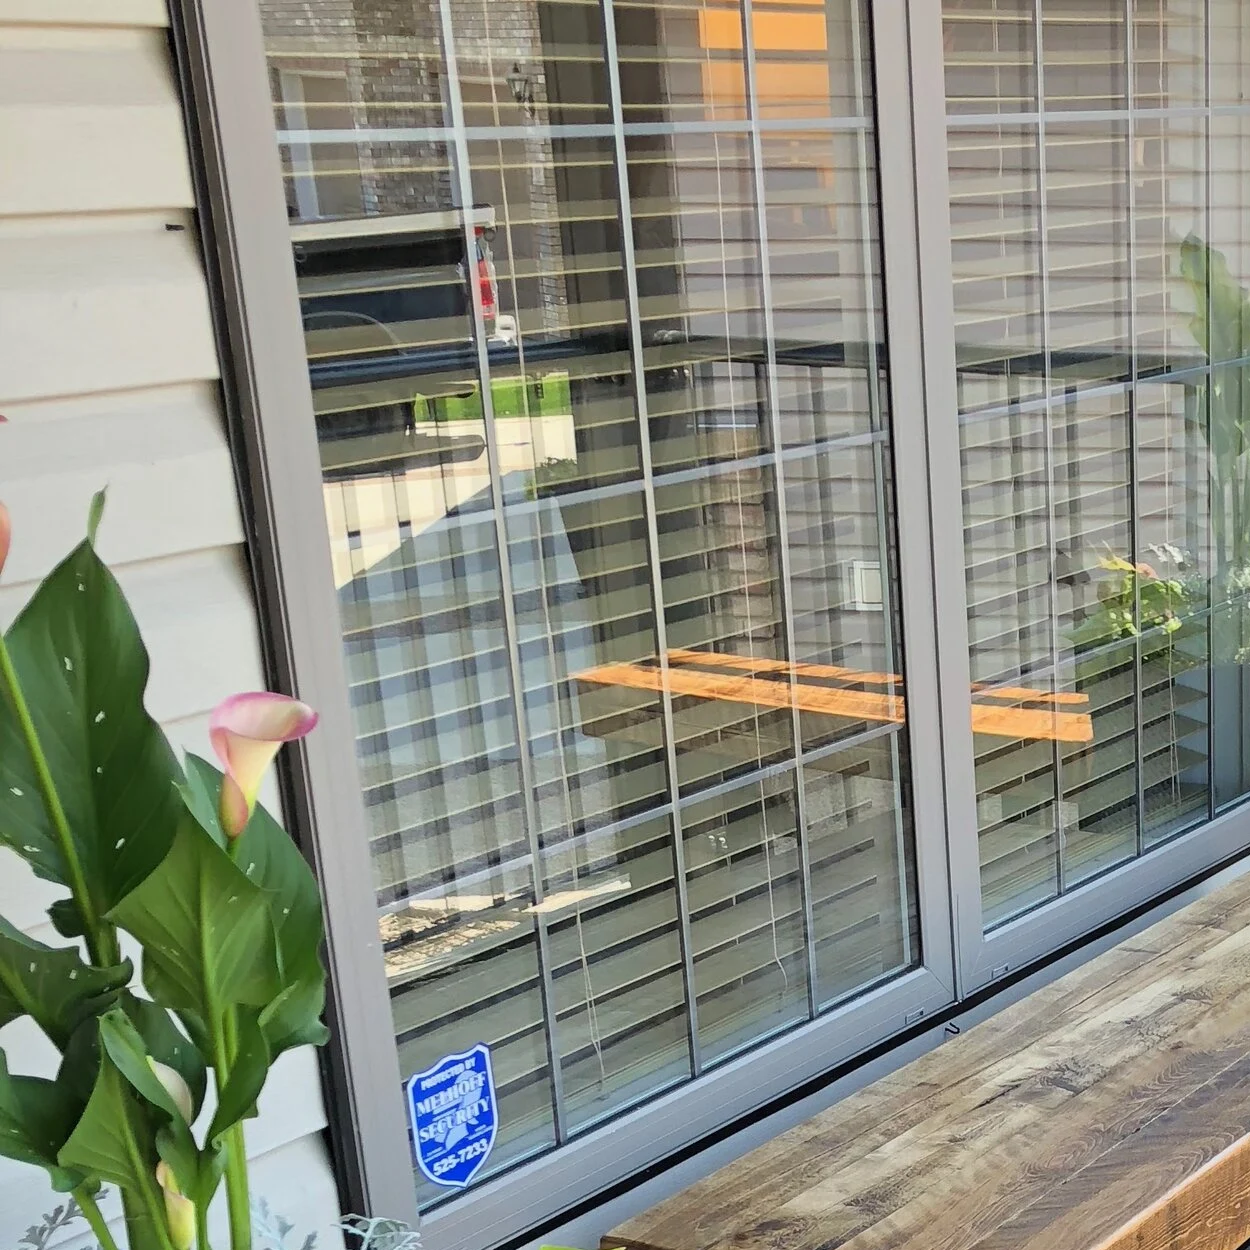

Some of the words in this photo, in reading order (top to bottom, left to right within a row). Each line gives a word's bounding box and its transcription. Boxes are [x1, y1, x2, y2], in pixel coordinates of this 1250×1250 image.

[464, 1057, 476, 1070] BY
[419, 1096, 491, 1143] SECURITY
[433, 1138, 488, 1176] 525-7233
